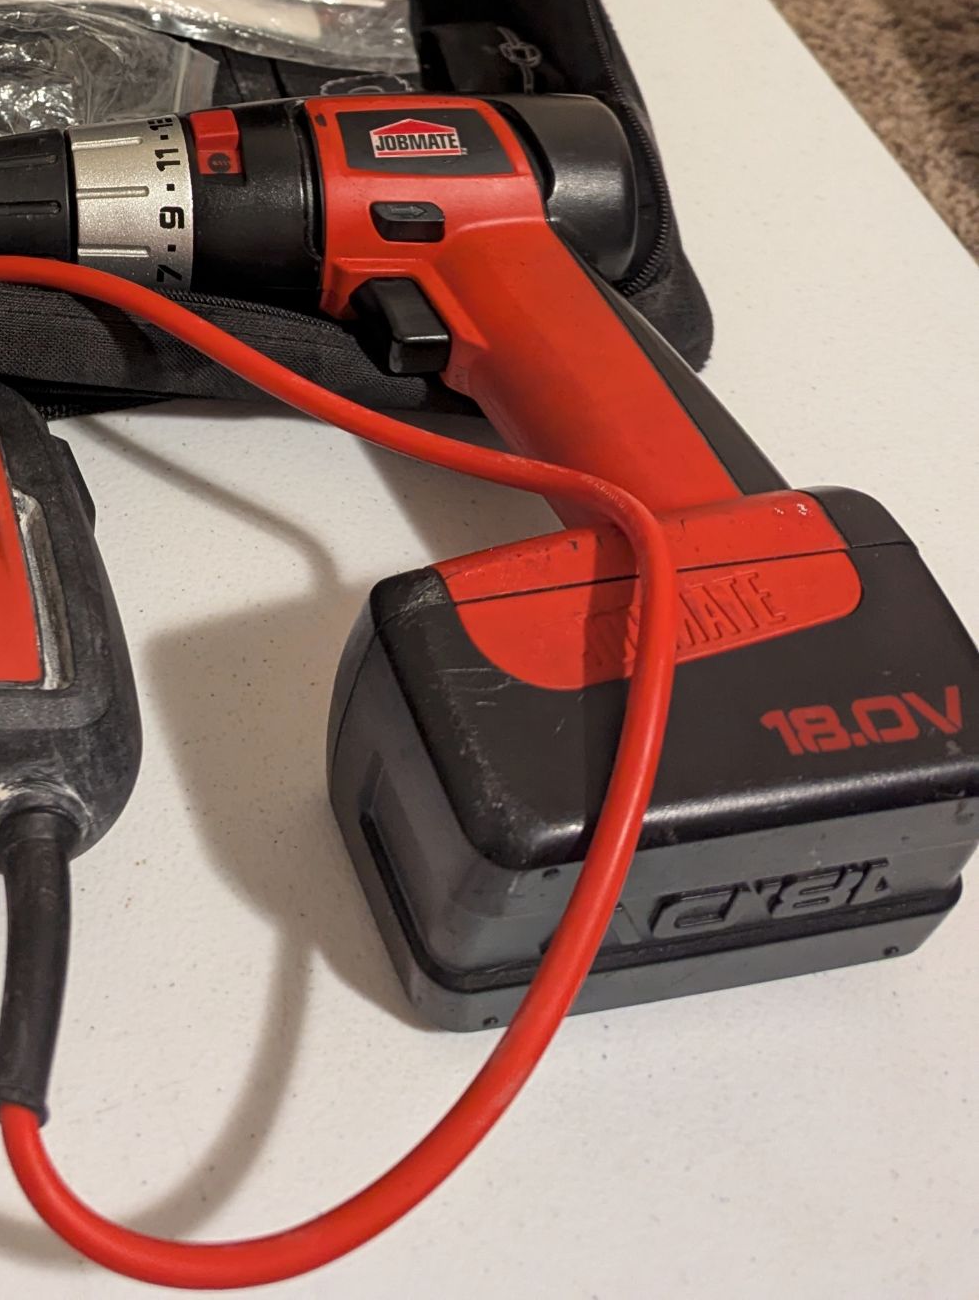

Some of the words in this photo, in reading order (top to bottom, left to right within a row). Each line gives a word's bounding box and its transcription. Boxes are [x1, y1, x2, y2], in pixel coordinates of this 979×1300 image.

[375, 132, 458, 151] JOBMATE
[155, 148, 181, 172] 11
[159, 206, 185, 230] 9
[157, 264, 182, 282] 7
[760, 686, 962, 756] 18.0V
